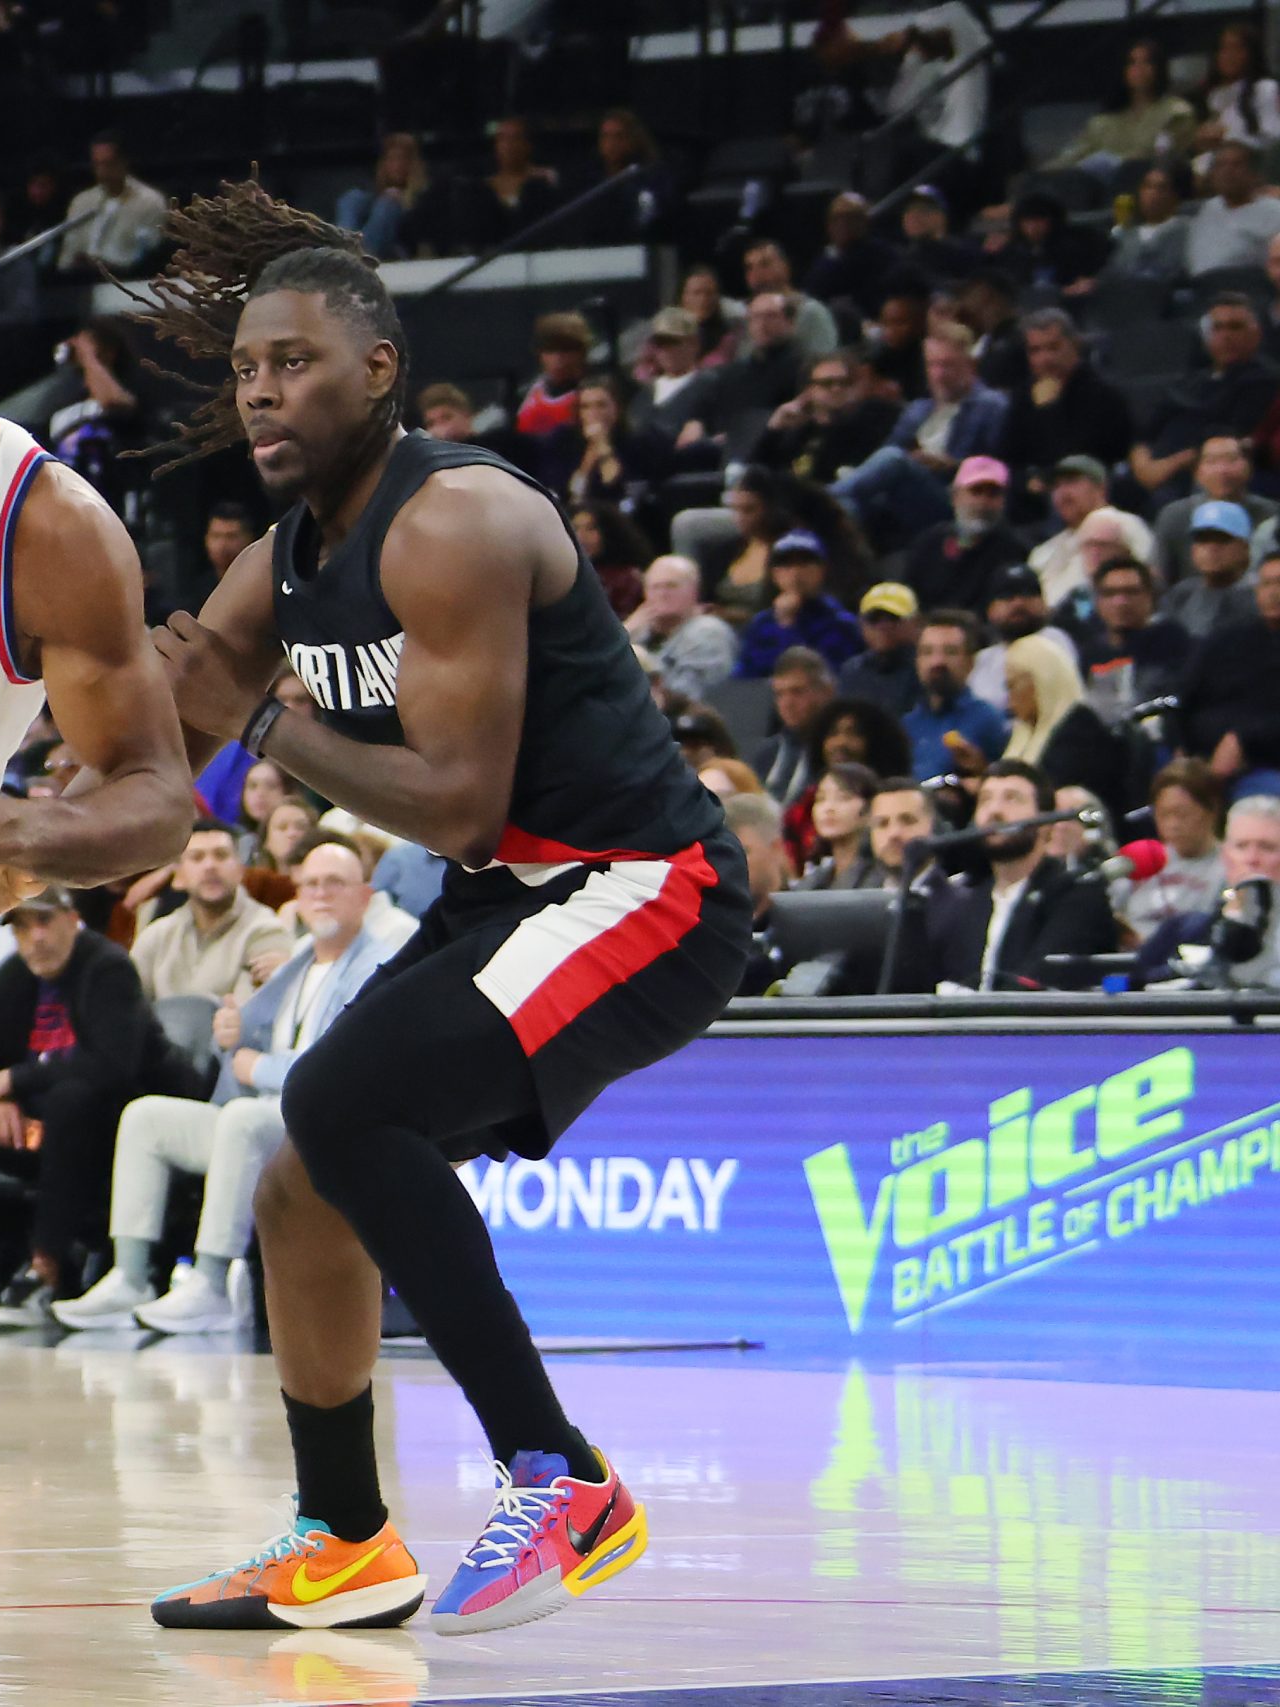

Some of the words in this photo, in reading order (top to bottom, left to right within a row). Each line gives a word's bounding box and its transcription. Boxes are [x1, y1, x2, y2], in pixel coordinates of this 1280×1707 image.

[281, 631, 405, 710] ORTLAN
[891, 1121, 949, 1166] the
[455, 1157, 740, 1232] MONDAY
[803, 1046, 1194, 1334] Voice
[892, 1199, 1056, 1312] BATTLE
